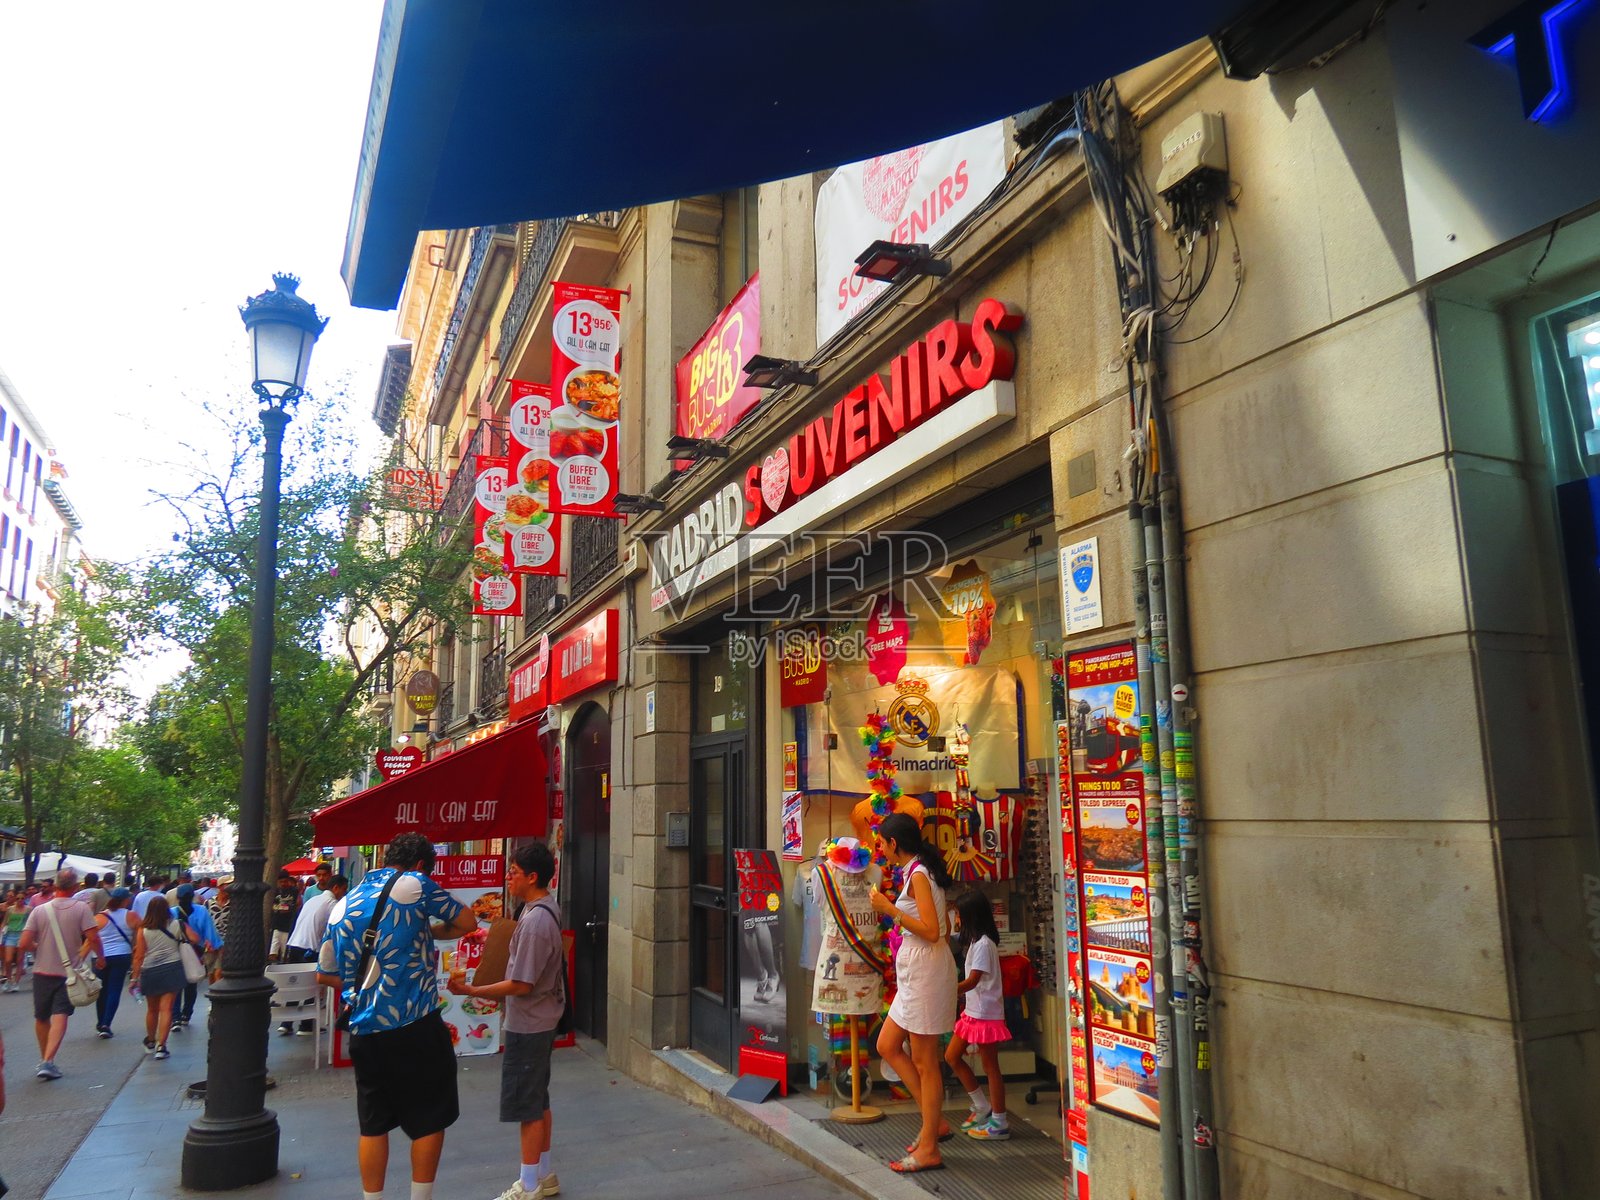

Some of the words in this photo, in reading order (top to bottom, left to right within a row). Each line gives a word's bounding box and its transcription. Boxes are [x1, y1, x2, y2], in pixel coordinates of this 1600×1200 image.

[690, 336, 719, 399] BIG
[688, 378, 715, 438] BUS
[569, 464, 598, 475] BUFFET
[569, 474, 591, 485] LIBRE
[521, 532, 545, 542] BUFFET
[651, 482, 743, 589] MADRID
[520, 541, 539, 550] LIBRE
[1071, 543, 1092, 556] ALARMA
[870, 642, 885, 653] FREE
[885, 635, 904, 648] MAPS
[783, 652, 805, 679] BUS
[1085, 661, 1109, 672] HOP-ON
[1109, 656, 1135, 669] HOP-OFF
[714, 675, 722, 693] 19
[1078, 782, 1101, 791] THINGS
[1102, 781, 1111, 790] TO
[1112, 781, 1121, 790] DO
[1102, 799, 1127, 807] EXPRESS
[395, 802, 419, 825] ALL
[426, 803, 435, 823] U
[439, 801, 467, 823] CAN
[472, 800, 498, 822] EAT
[458, 860, 477, 875] CAN
[480, 859, 498, 875] EAT
[1085, 874, 1107, 883] SEGOVIA
[1108, 876, 1130, 885] TOLEDO
[740, 891, 767, 911] CO
[1104, 953, 1126, 964] SEGOVIA
[1093, 1036, 1114, 1049] TOLEDO
[1122, 1036, 1151, 1052] ARANJUEZ
